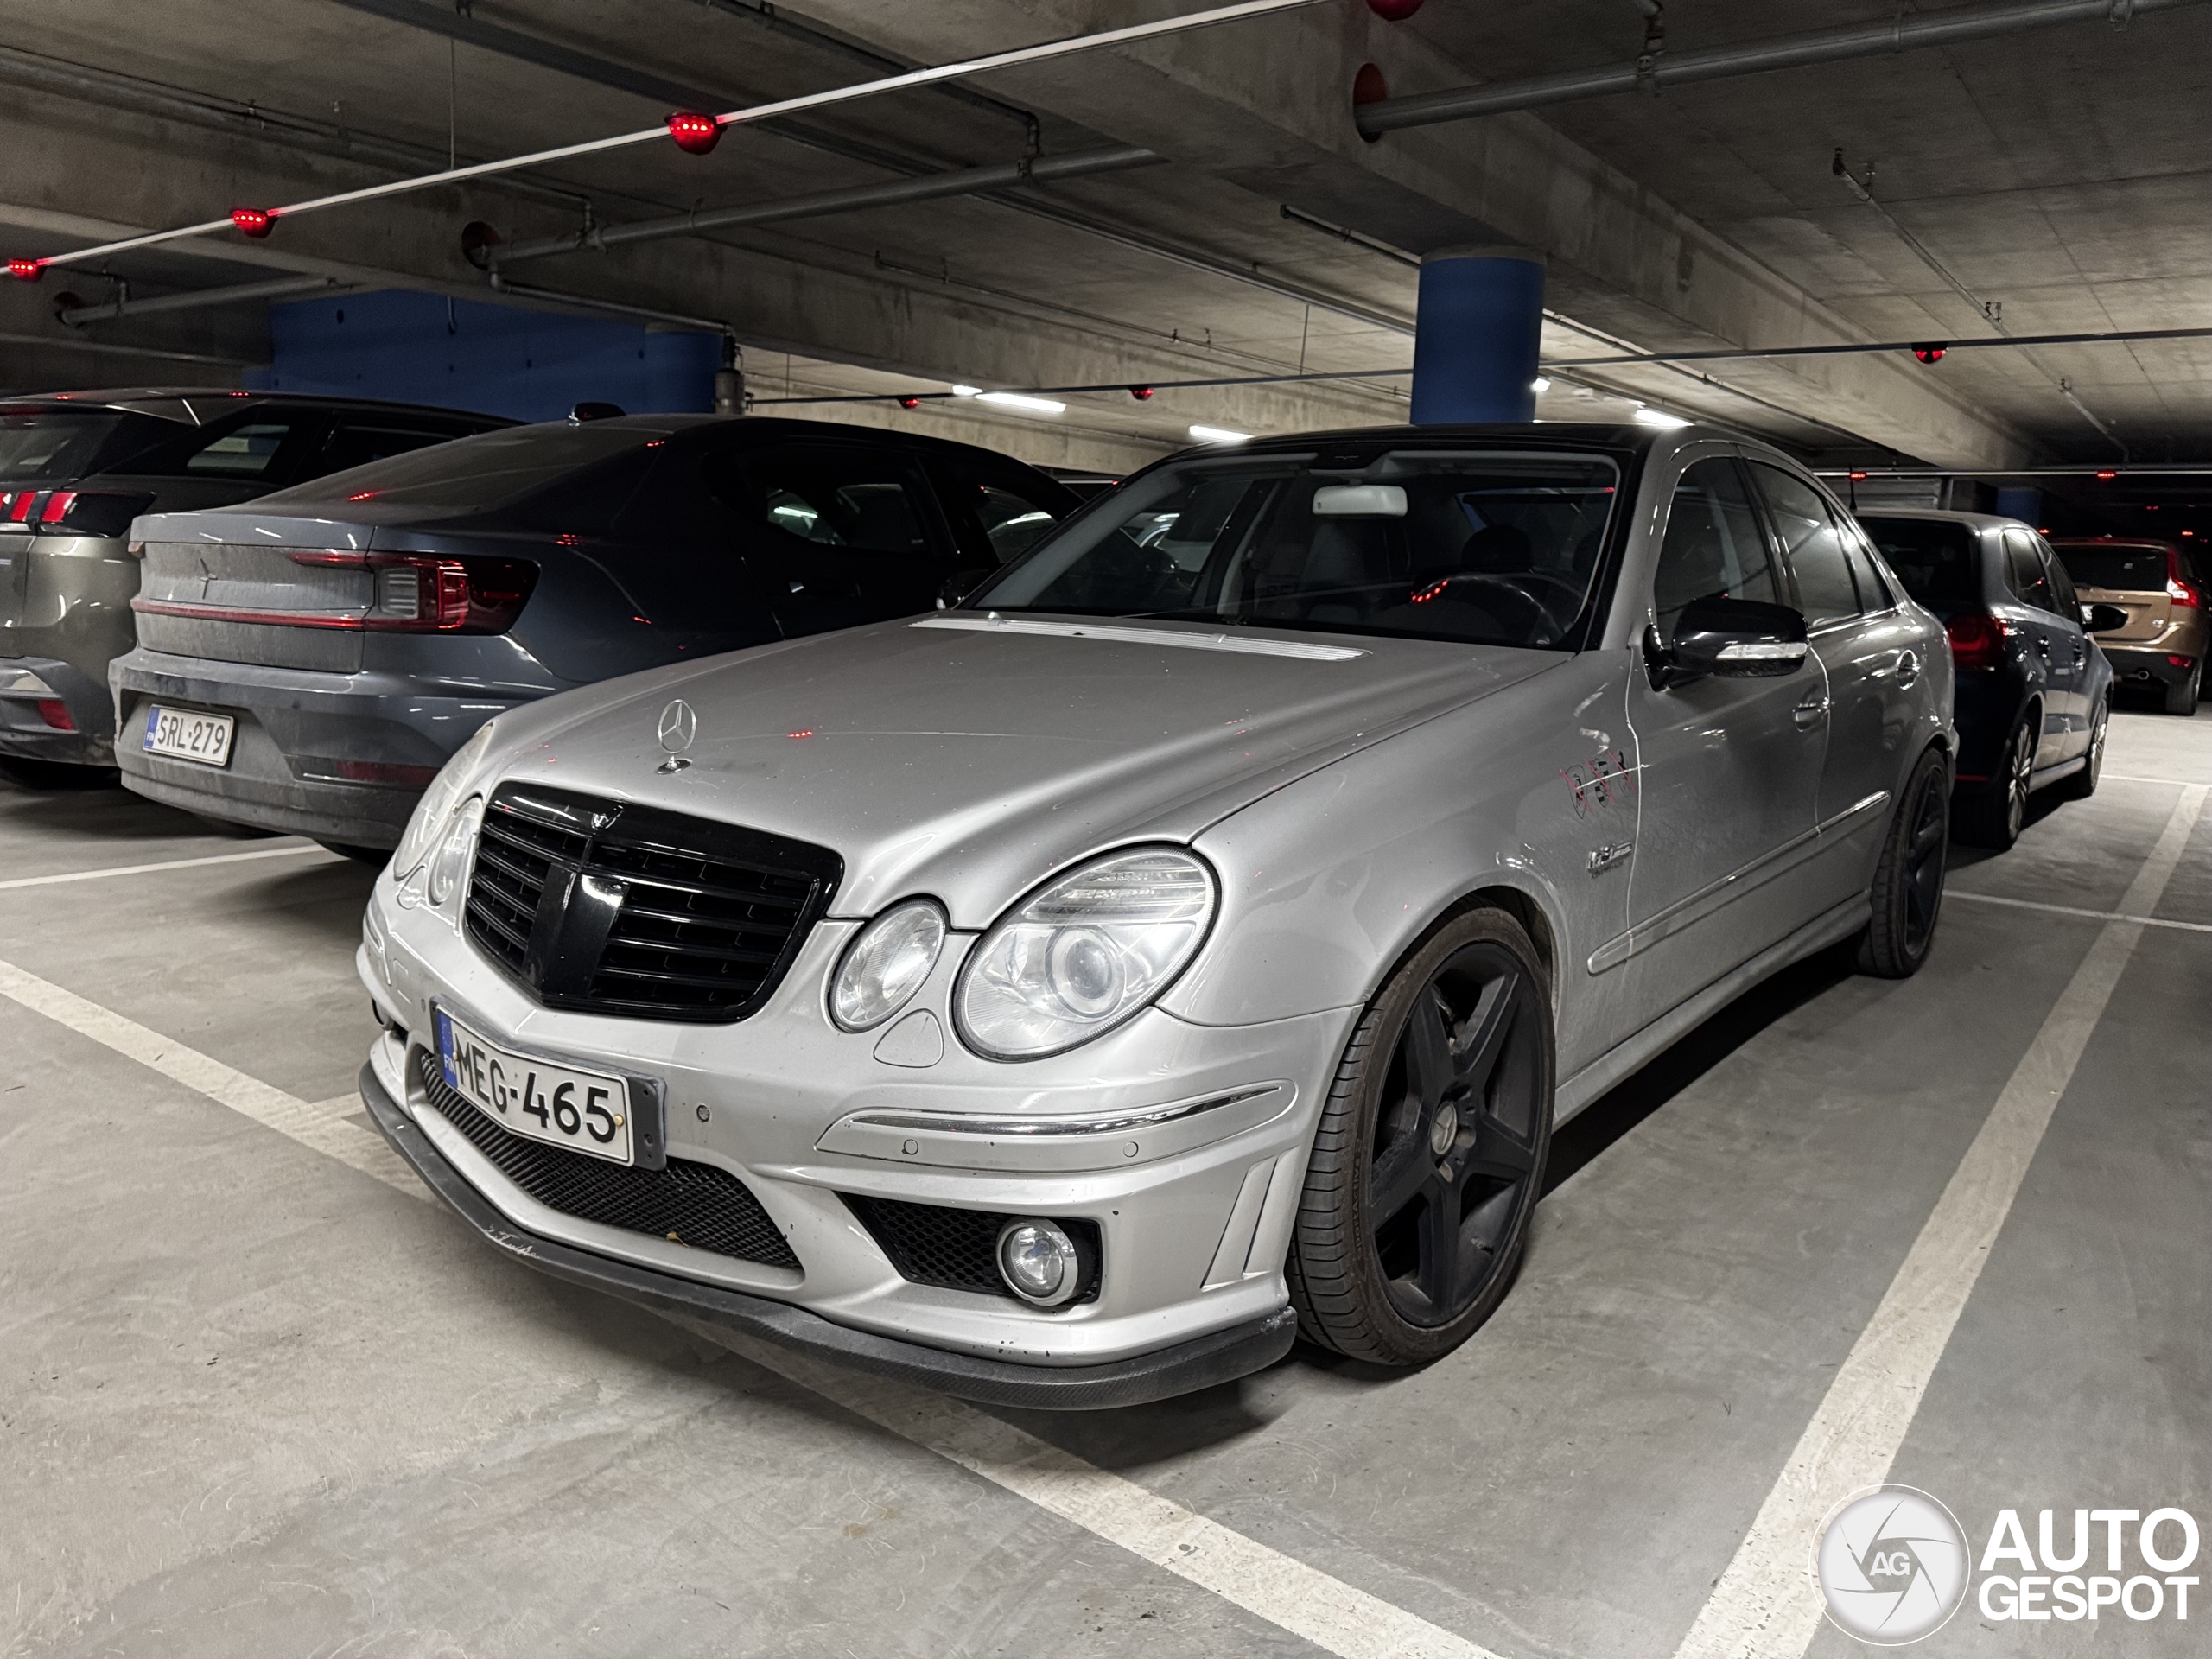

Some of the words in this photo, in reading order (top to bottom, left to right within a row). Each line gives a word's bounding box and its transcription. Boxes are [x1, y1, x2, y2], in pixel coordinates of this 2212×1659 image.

[157, 715, 225, 754] SRL-279
[443, 1052, 456, 1076] FIN
[454, 1032, 617, 1144] MEG-465
